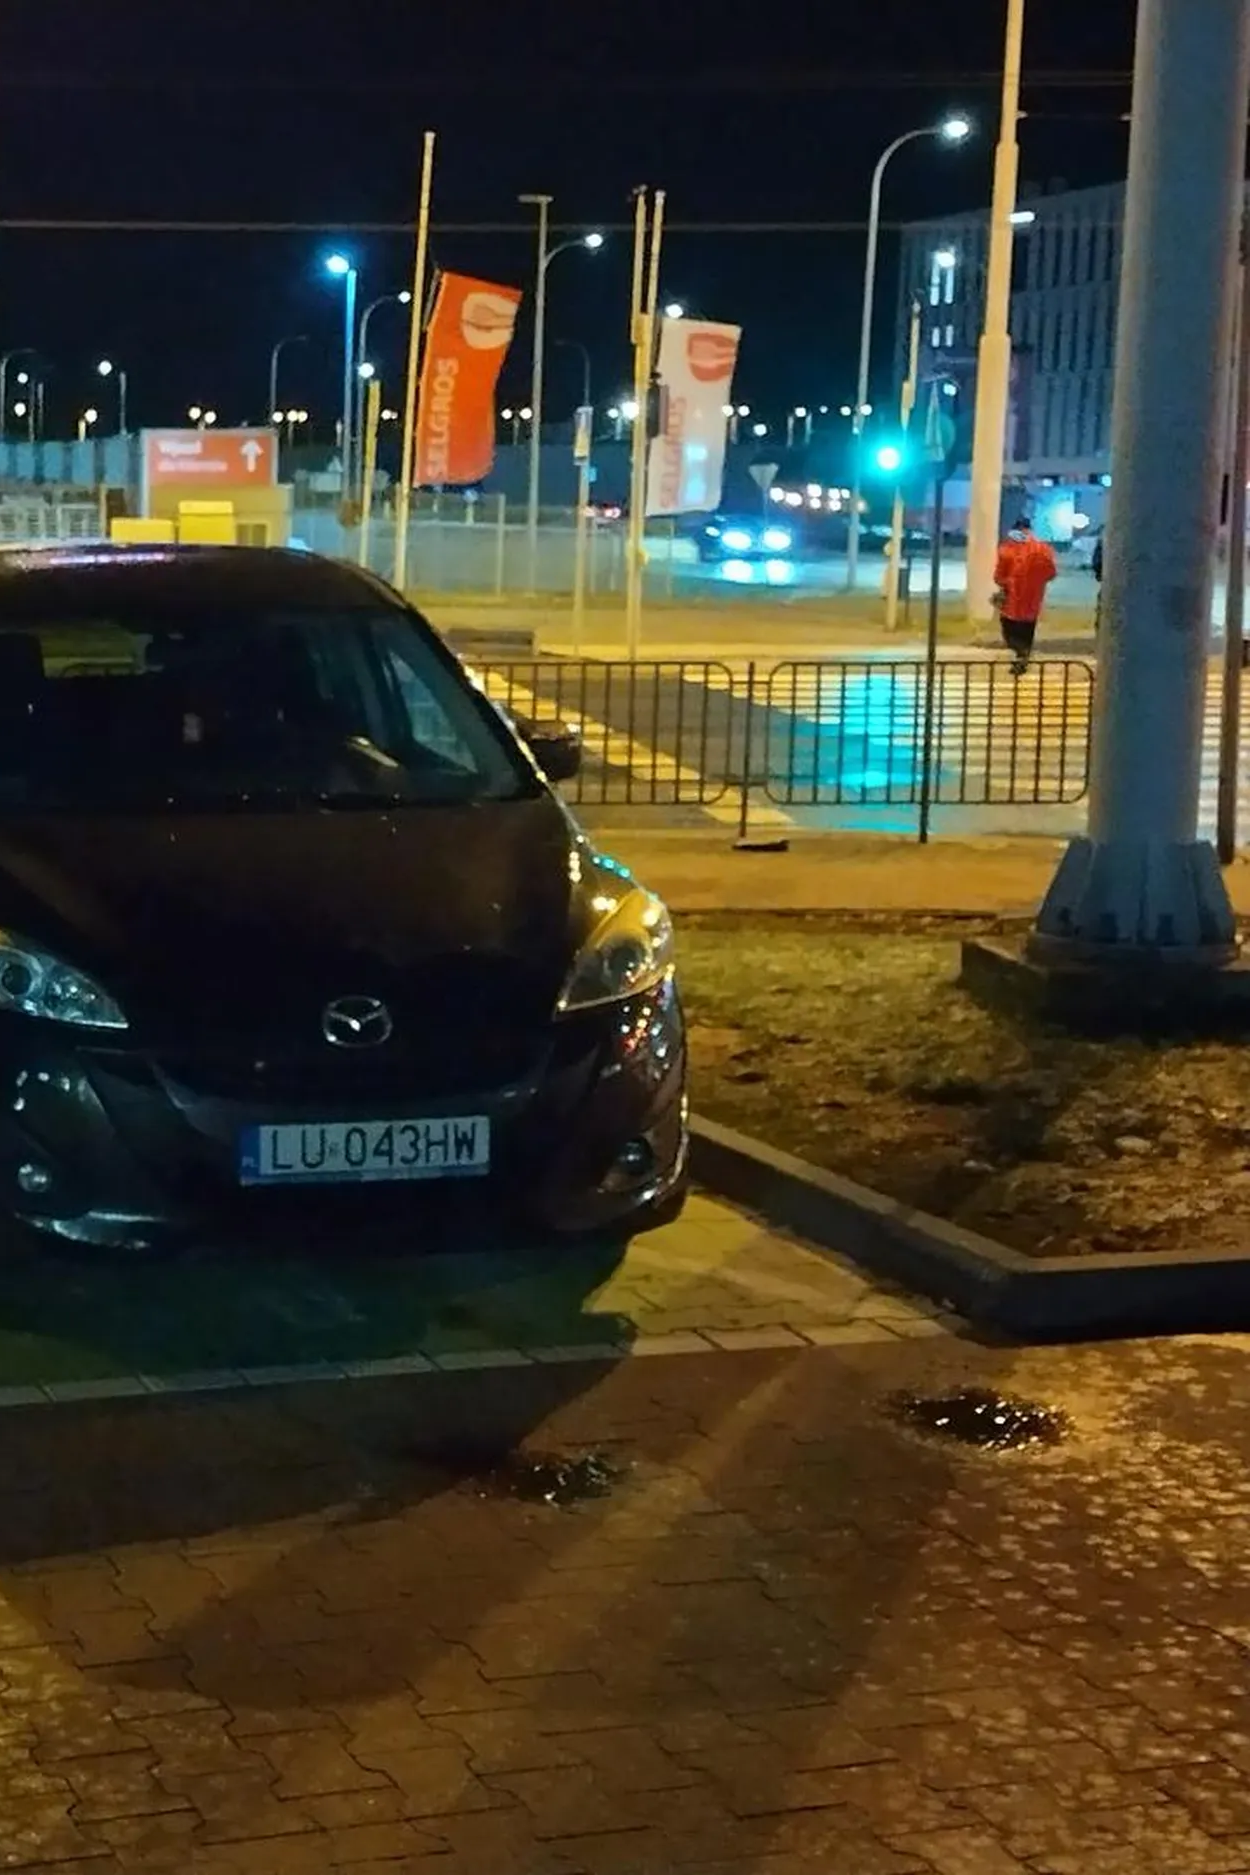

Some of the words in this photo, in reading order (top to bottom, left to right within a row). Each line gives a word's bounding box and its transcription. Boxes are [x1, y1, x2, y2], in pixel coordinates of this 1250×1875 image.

[426, 357, 459, 481] SELGROS
[271, 1128, 326, 1170] LU
[344, 1121, 478, 1167] 043HW
